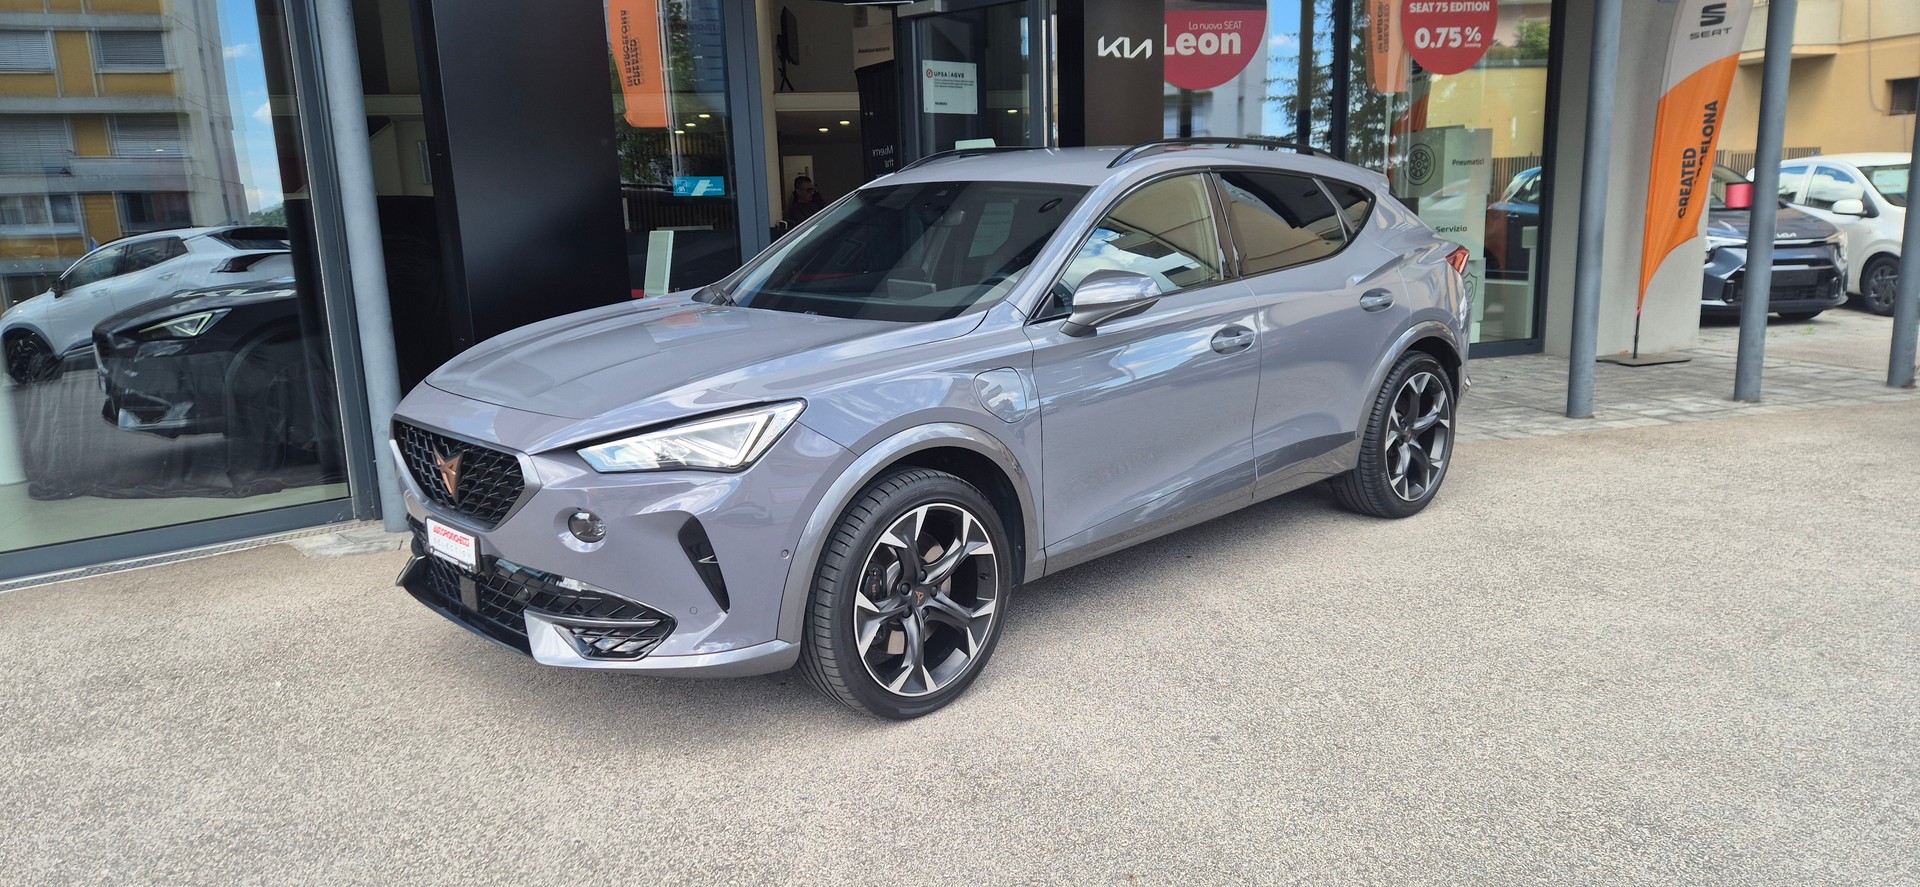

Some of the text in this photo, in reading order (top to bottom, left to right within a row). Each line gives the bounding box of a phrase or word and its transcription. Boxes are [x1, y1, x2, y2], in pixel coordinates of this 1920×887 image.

[1409, 1, 1490, 13] SEAT 75 EDITION
[1188, 20, 1243, 30] La nuova SEAT
[1689, 26, 1733, 40] SEAT
[1164, 24, 1241, 56] Leon
[1451, 158, 1485, 166] Pneumatici
[1435, 224, 1468, 233] Servizio
